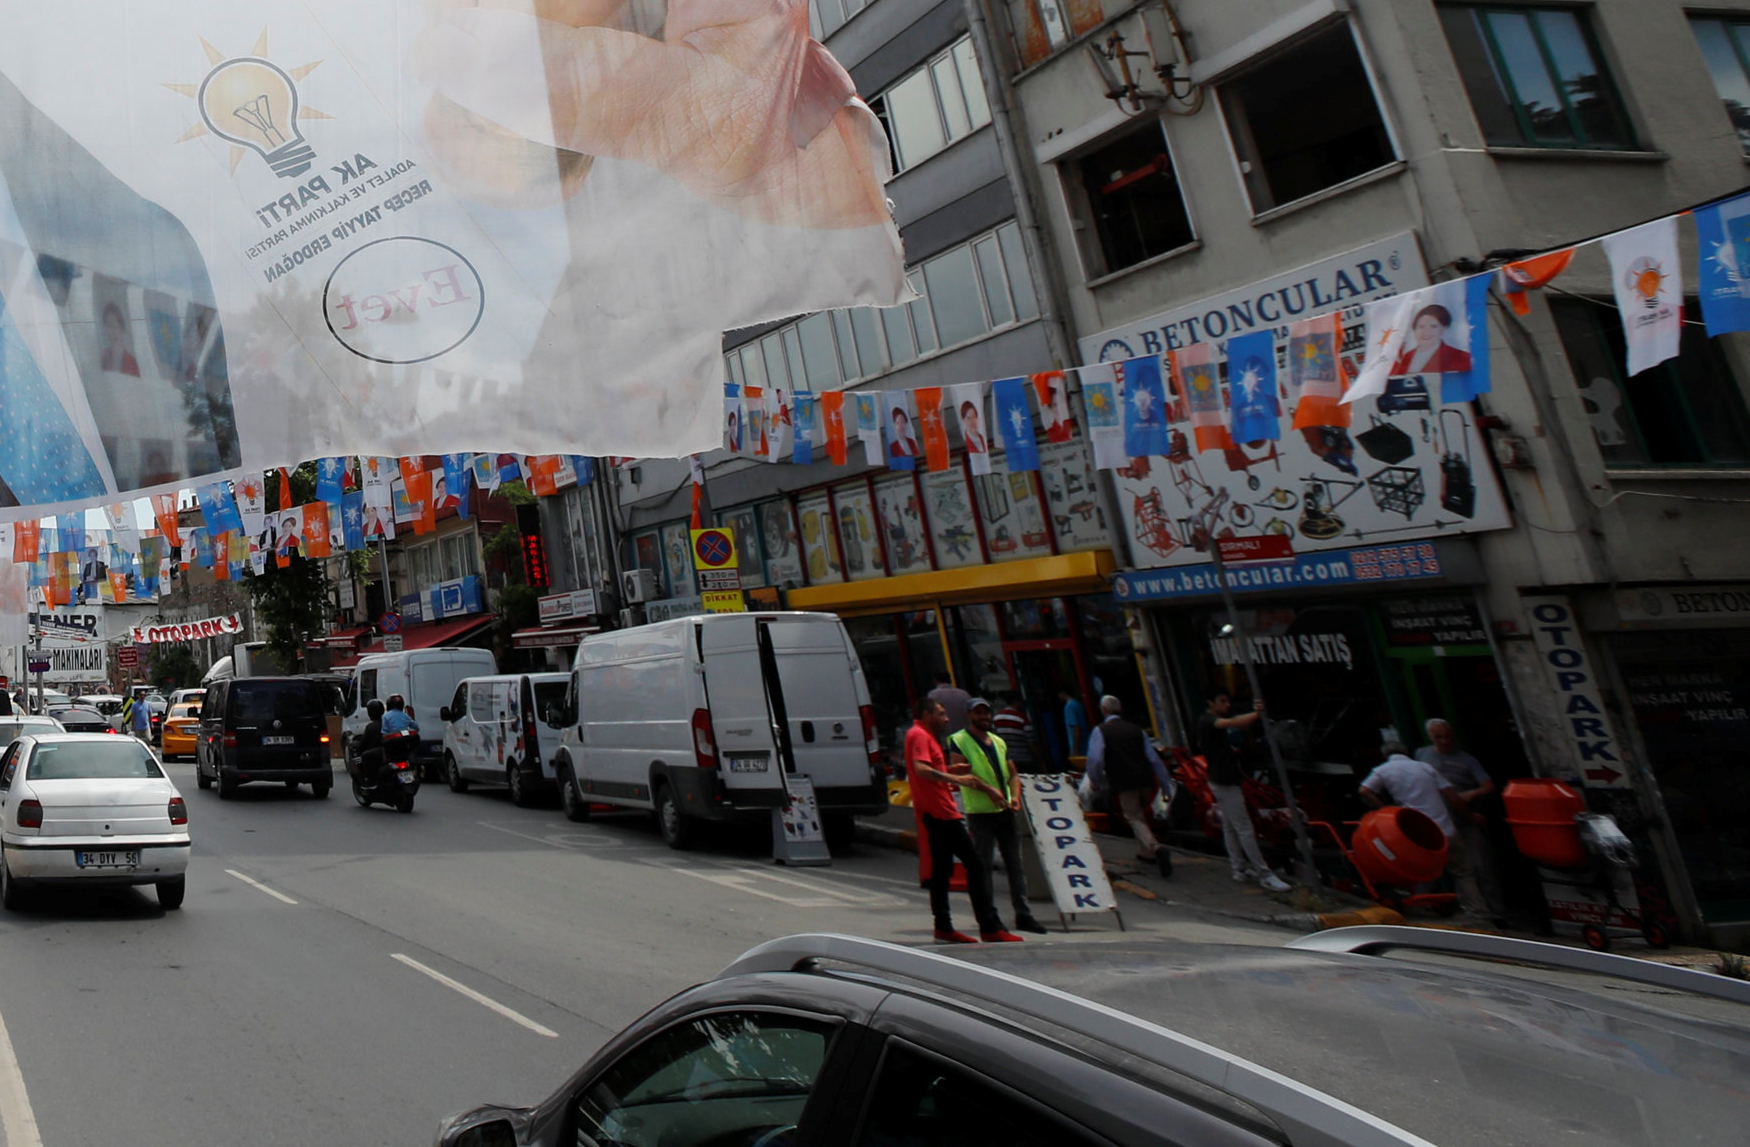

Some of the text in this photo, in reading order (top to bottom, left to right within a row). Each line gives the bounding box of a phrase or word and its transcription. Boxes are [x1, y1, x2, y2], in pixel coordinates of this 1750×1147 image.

[1140, 258, 1392, 353] BETONCULAR
[1533, 604, 1619, 762] OTOPARK
[83, 853, 94, 864] 34
